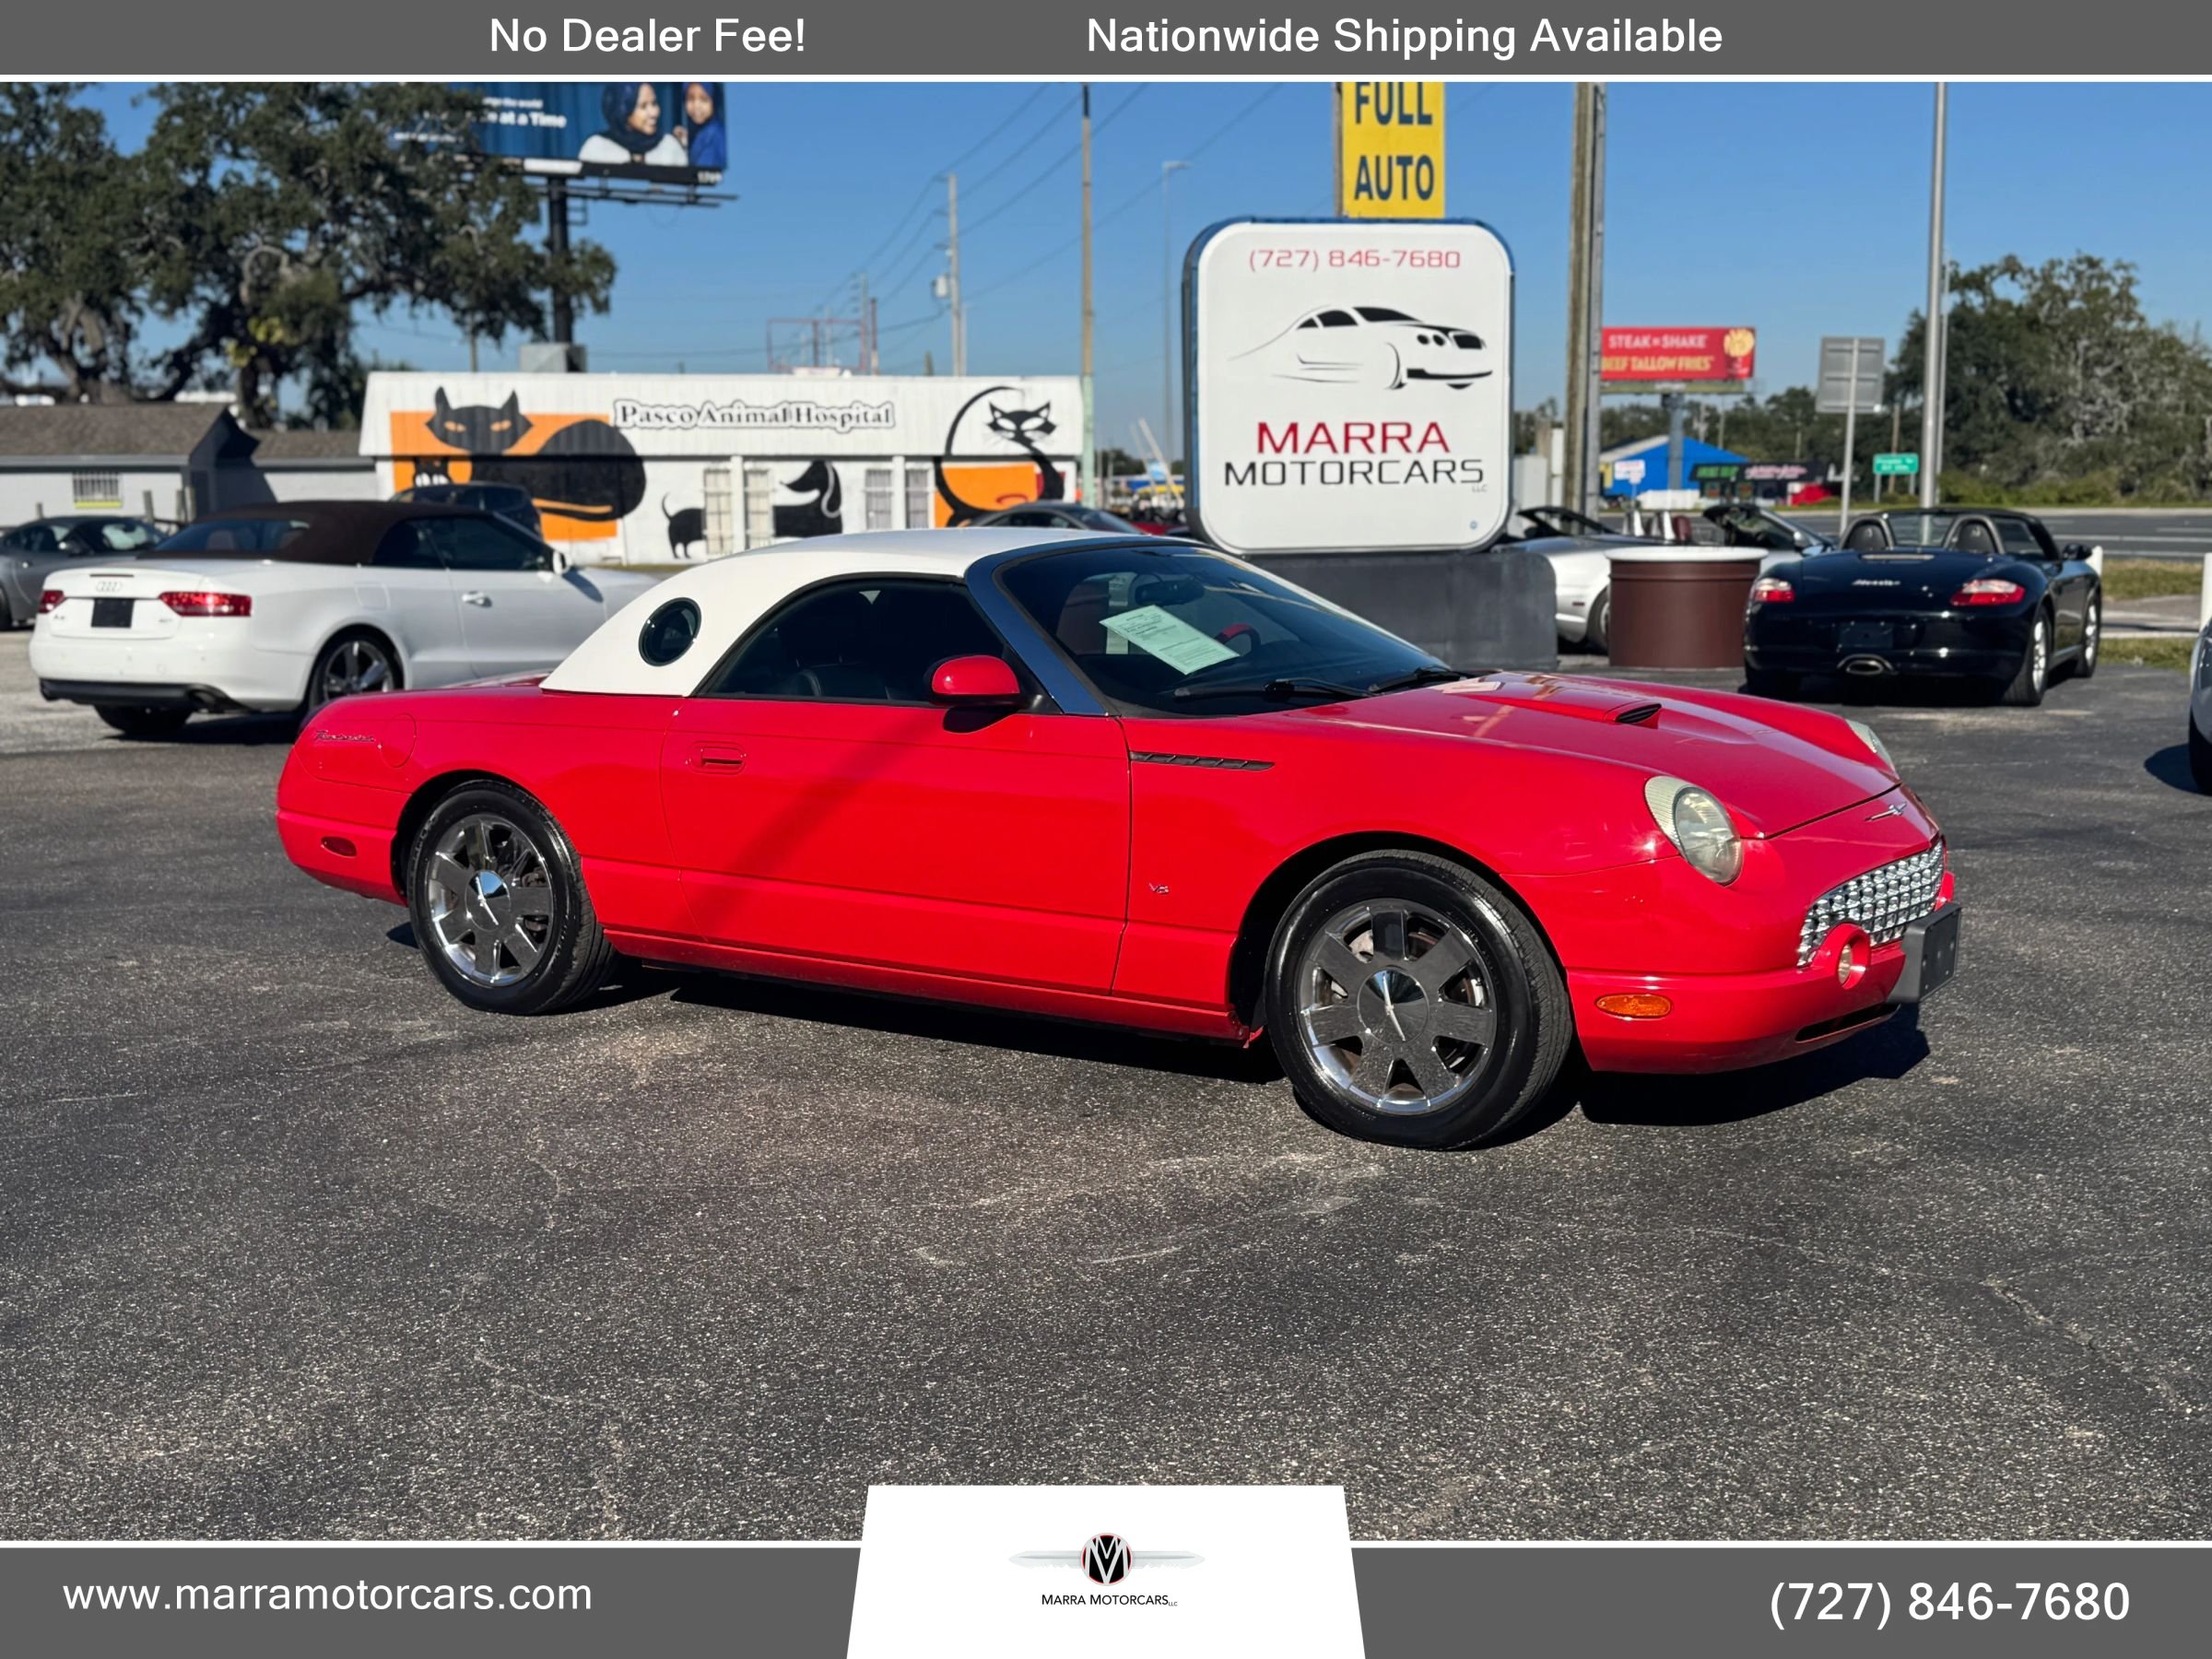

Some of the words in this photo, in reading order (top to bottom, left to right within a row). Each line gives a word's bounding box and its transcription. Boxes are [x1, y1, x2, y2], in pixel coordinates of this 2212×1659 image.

[1355, 82, 1433, 125] FULL
[530, 112, 567, 127] Time
[1353, 154, 1434, 202] AUTO
[1249, 250, 1320, 272] (727)
[1328, 250, 1461, 268] 846-7680
[1607, 334, 1651, 349] STEAK
[1662, 334, 1707, 349] SHAKE
[619, 404, 695, 424] Pasco
[699, 404, 788, 424] Animal
[794, 405, 891, 429] Hospital
[1257, 421, 1451, 453] MARRA
[1224, 459, 1484, 487] MOTORCARS
